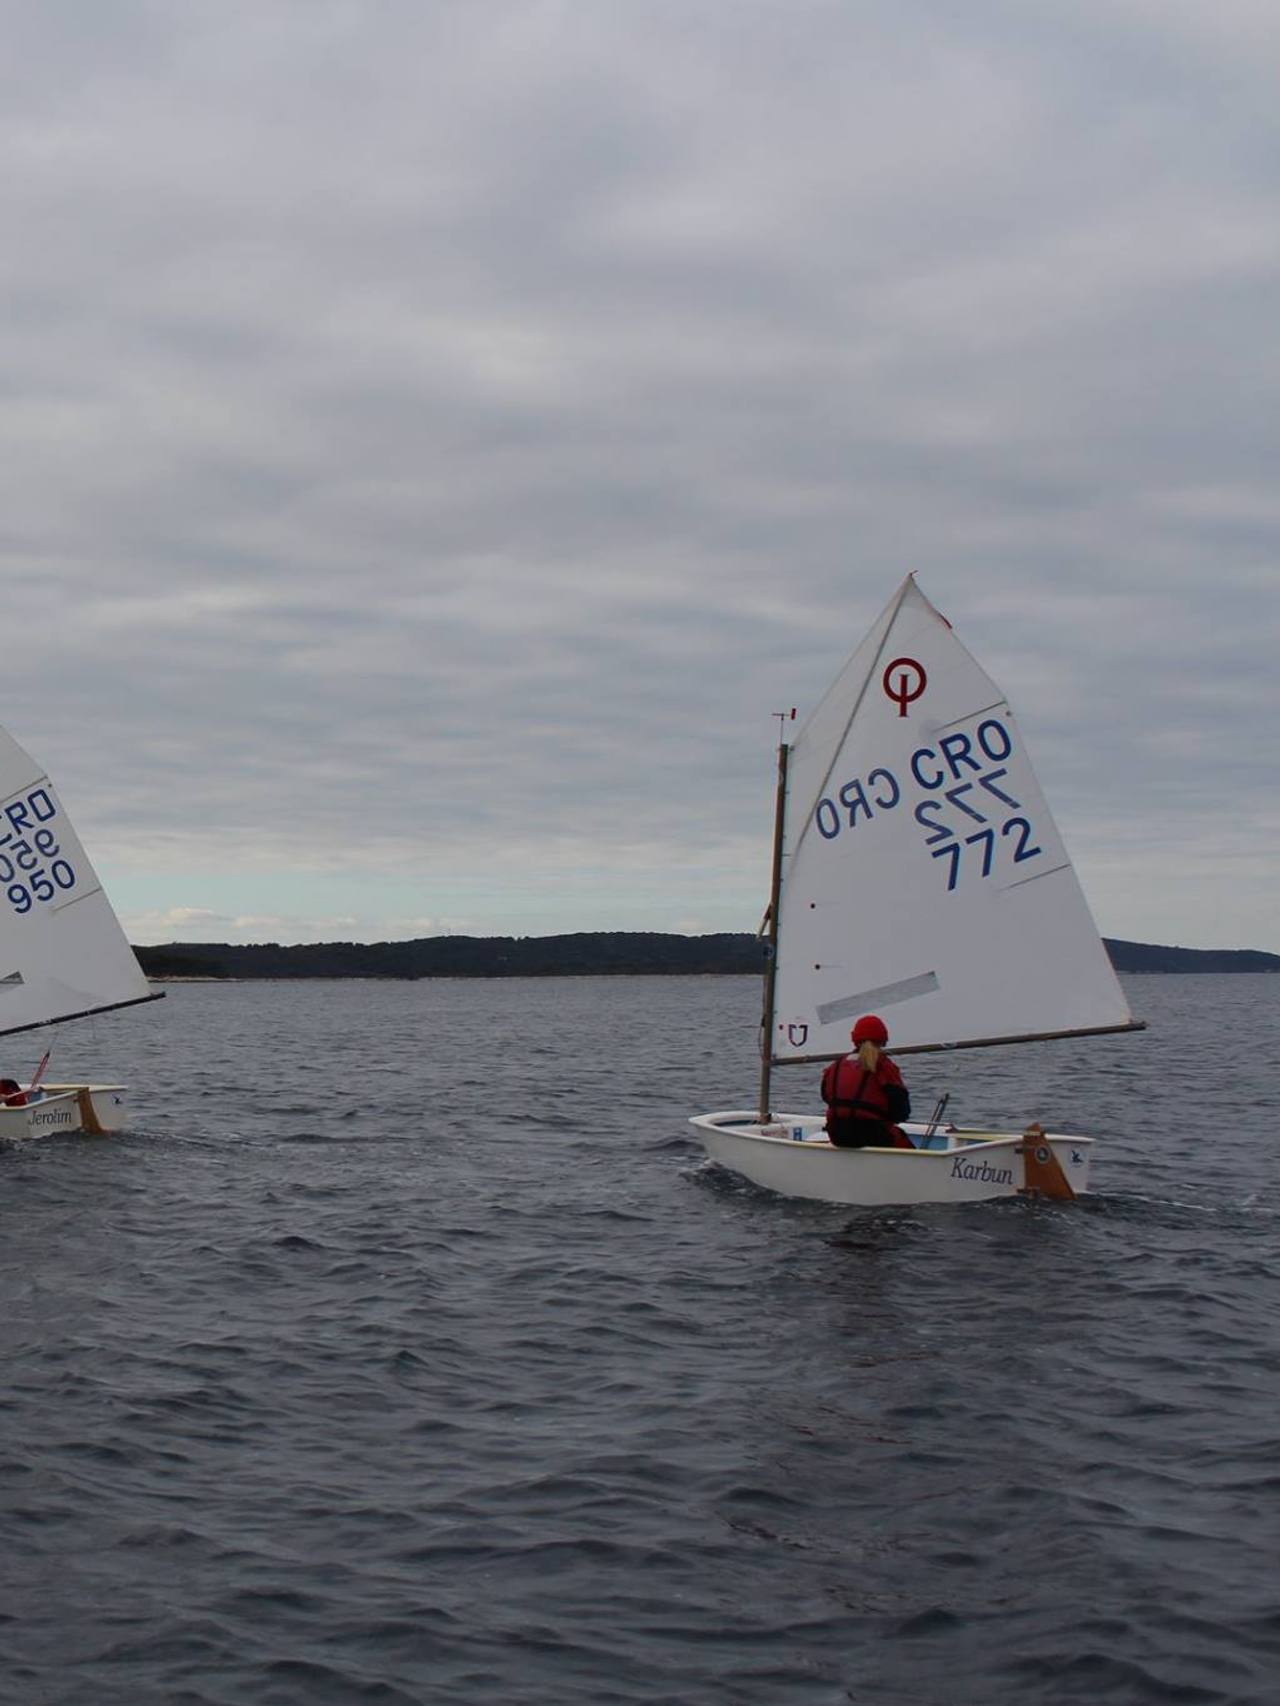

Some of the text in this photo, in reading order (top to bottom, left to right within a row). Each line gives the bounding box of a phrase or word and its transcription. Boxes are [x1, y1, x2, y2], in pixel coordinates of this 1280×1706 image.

[911, 719, 1012, 790] CRO
[932, 817, 1042, 891] 772
[7, 860, 76, 914] 950
[28, 1108, 72, 1126] Jerolim
[951, 1157, 1013, 1185] Karbun
